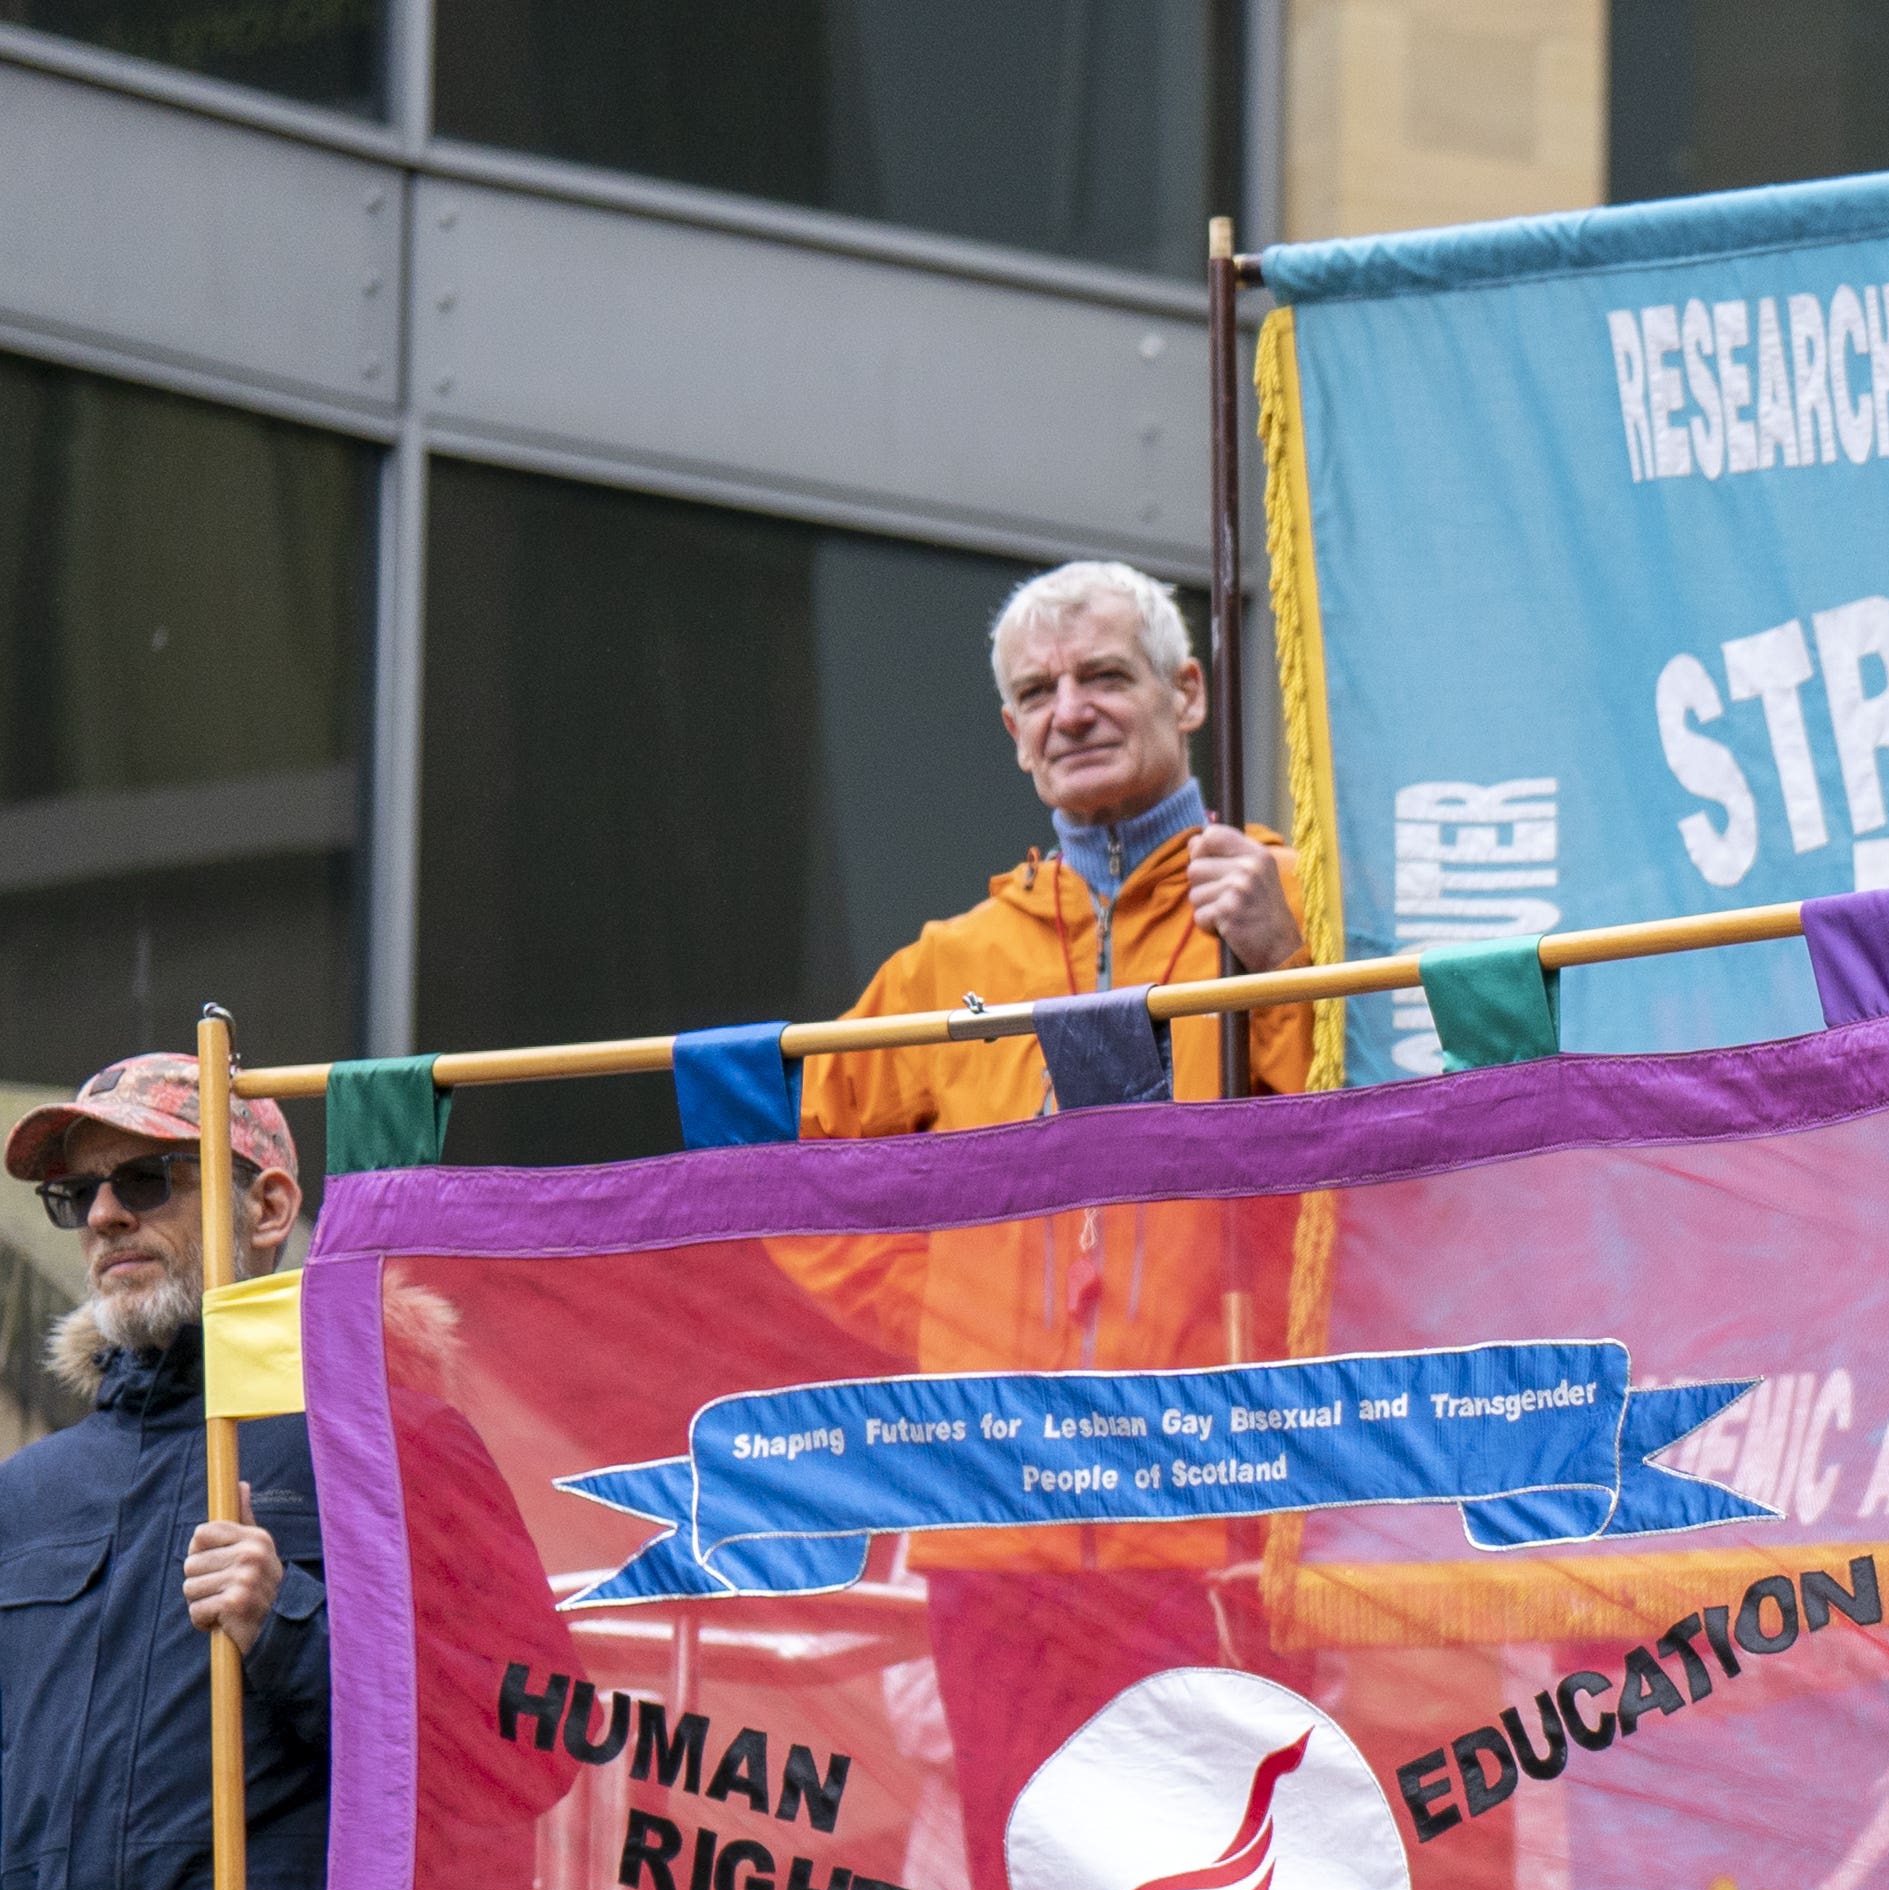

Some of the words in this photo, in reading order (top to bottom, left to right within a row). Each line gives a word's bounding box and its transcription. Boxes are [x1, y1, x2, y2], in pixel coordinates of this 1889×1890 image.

[733, 1426, 844, 1461] Shaping
[866, 1416, 966, 1446] Futures
[980, 1412, 1022, 1440] for
[1044, 1412, 1147, 1440] Lesbian
[1162, 1407, 1212, 1442] Gay
[1230, 1400, 1342, 1433] Bisexual
[1358, 1392, 1408, 1420] and
[1430, 1379, 1597, 1424] Transgender
[1022, 1463, 1118, 1495] People
[1135, 1461, 1161, 1489] of
[1171, 1453, 1288, 1489] Scotland
[498, 1661, 851, 1834] HUMAN
[1395, 1554, 1883, 1843] EDUCATION
